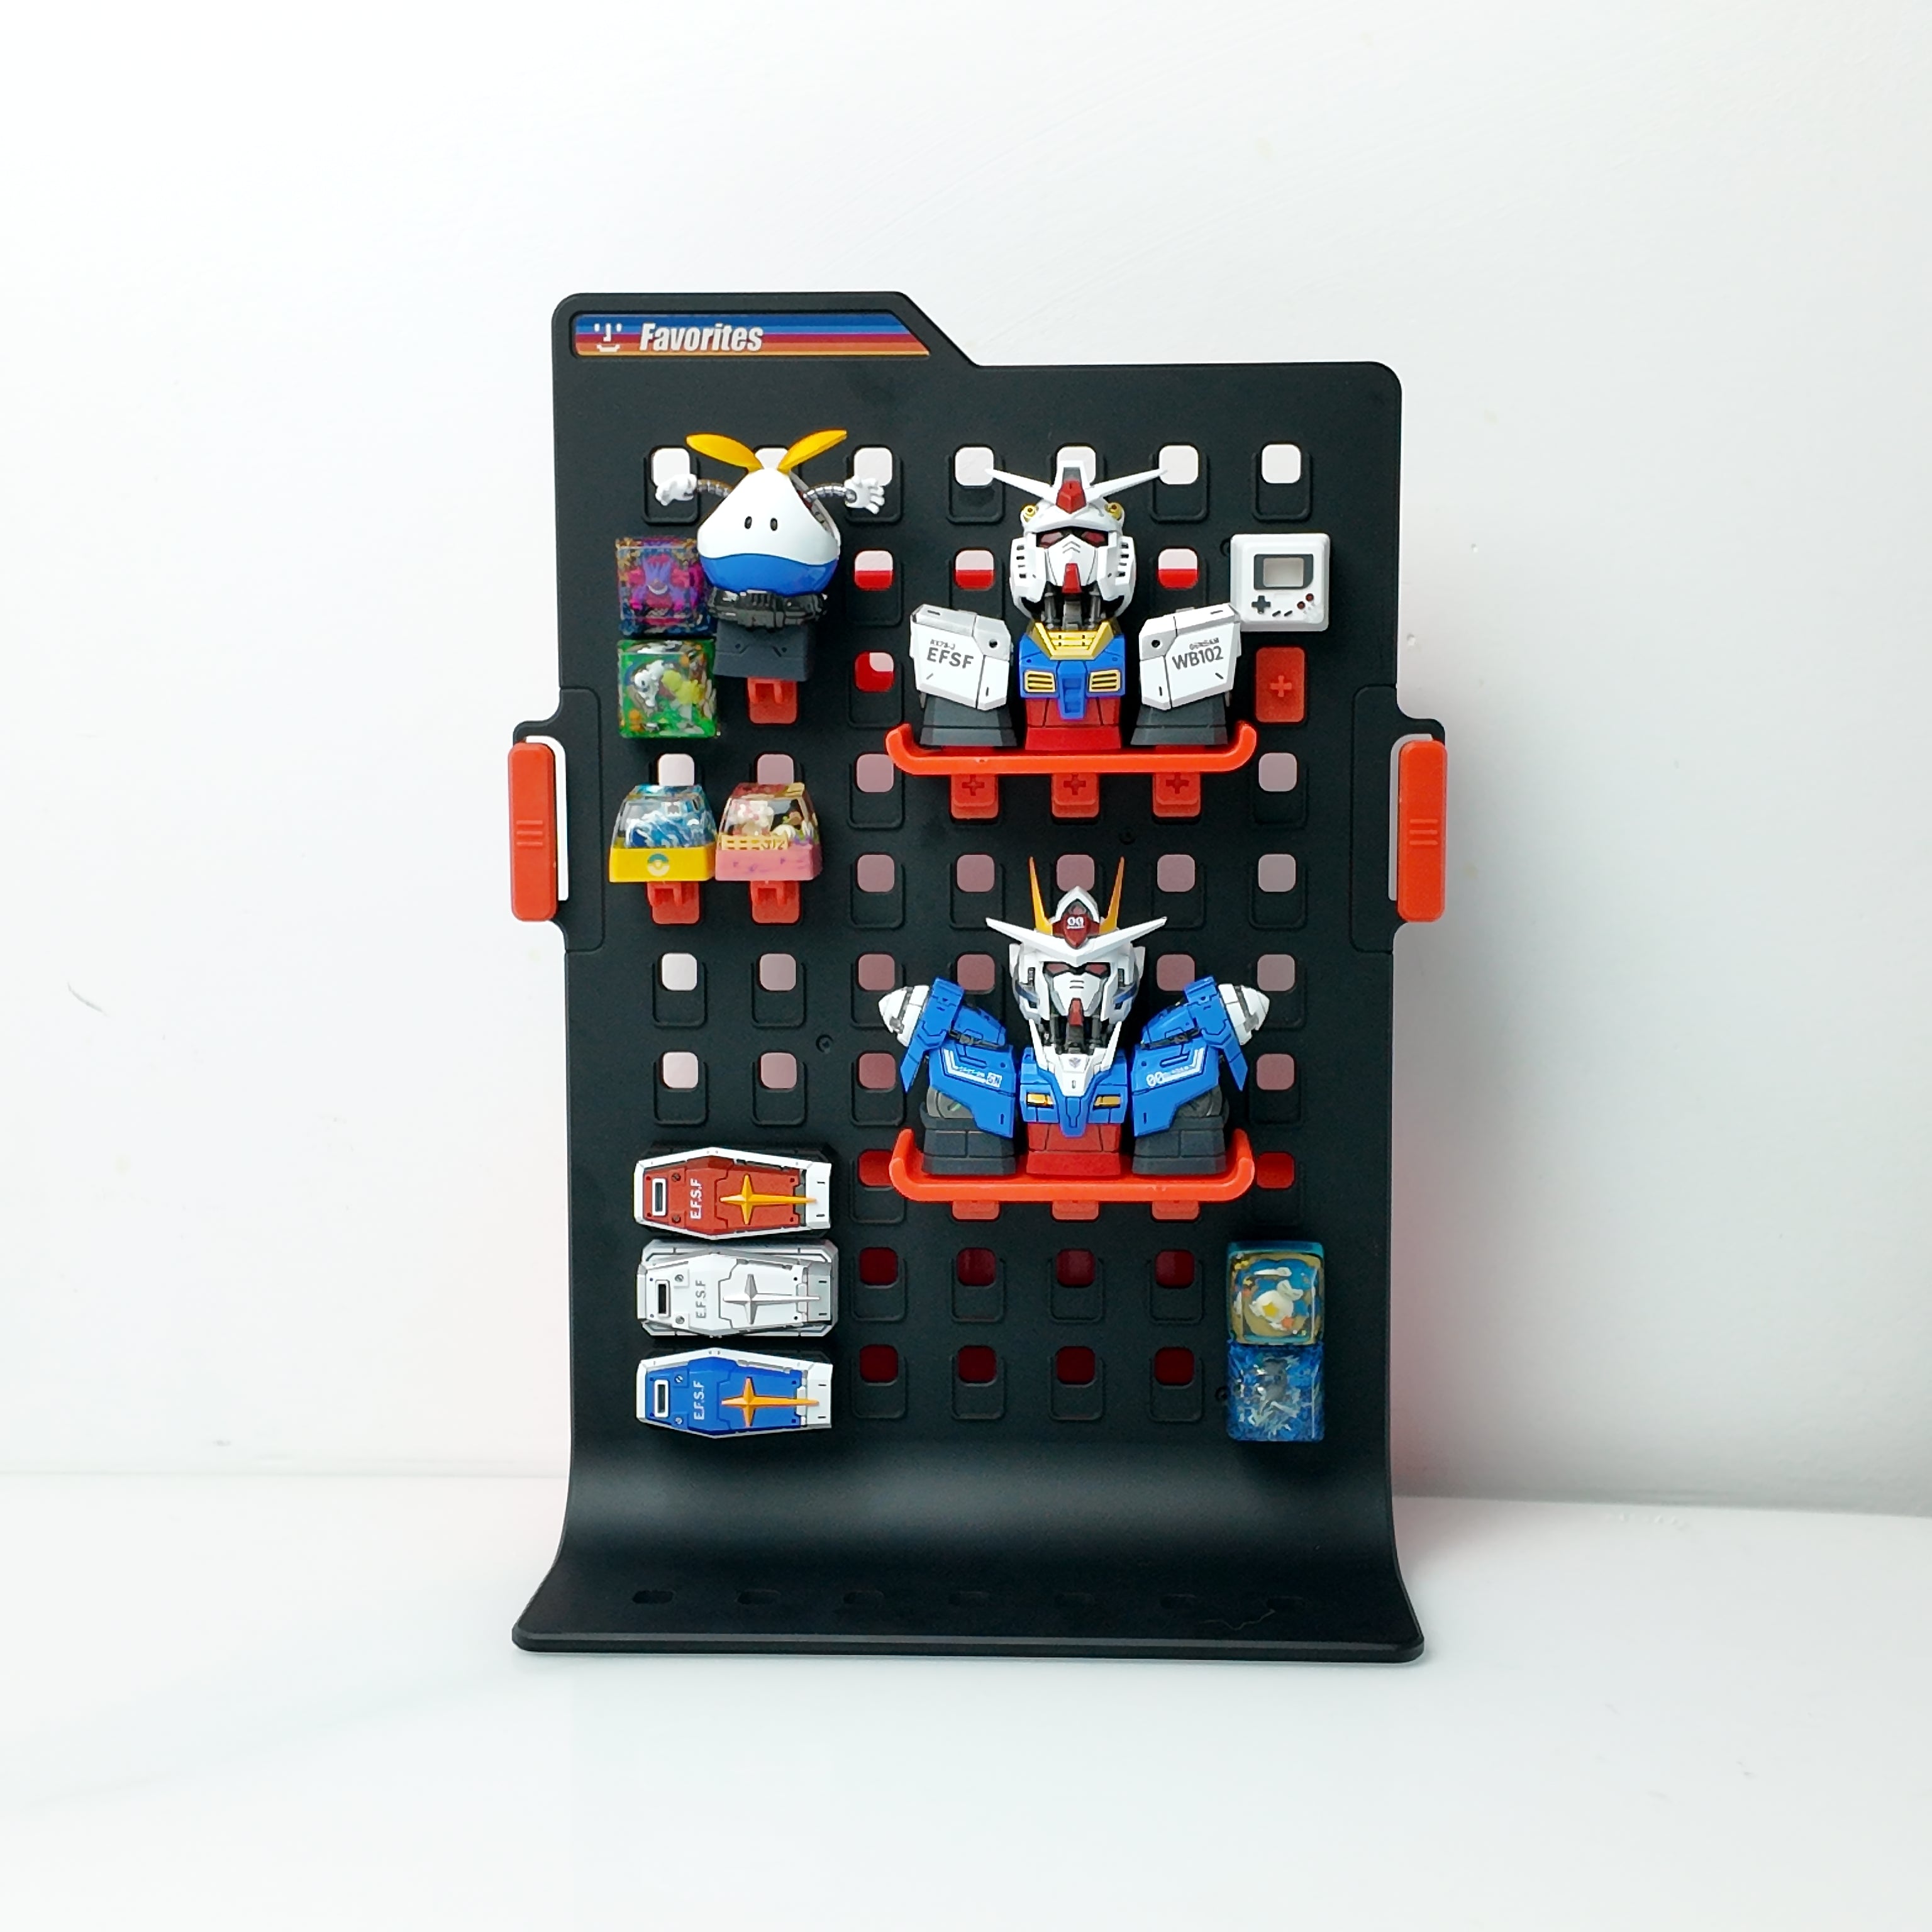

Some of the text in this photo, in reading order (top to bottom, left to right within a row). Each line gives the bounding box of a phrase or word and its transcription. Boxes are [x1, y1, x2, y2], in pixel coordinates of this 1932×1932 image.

[639, 322, 763, 352] Favorites
[927, 647, 974, 669] EFSF
[1172, 646, 1224, 670] WB102
